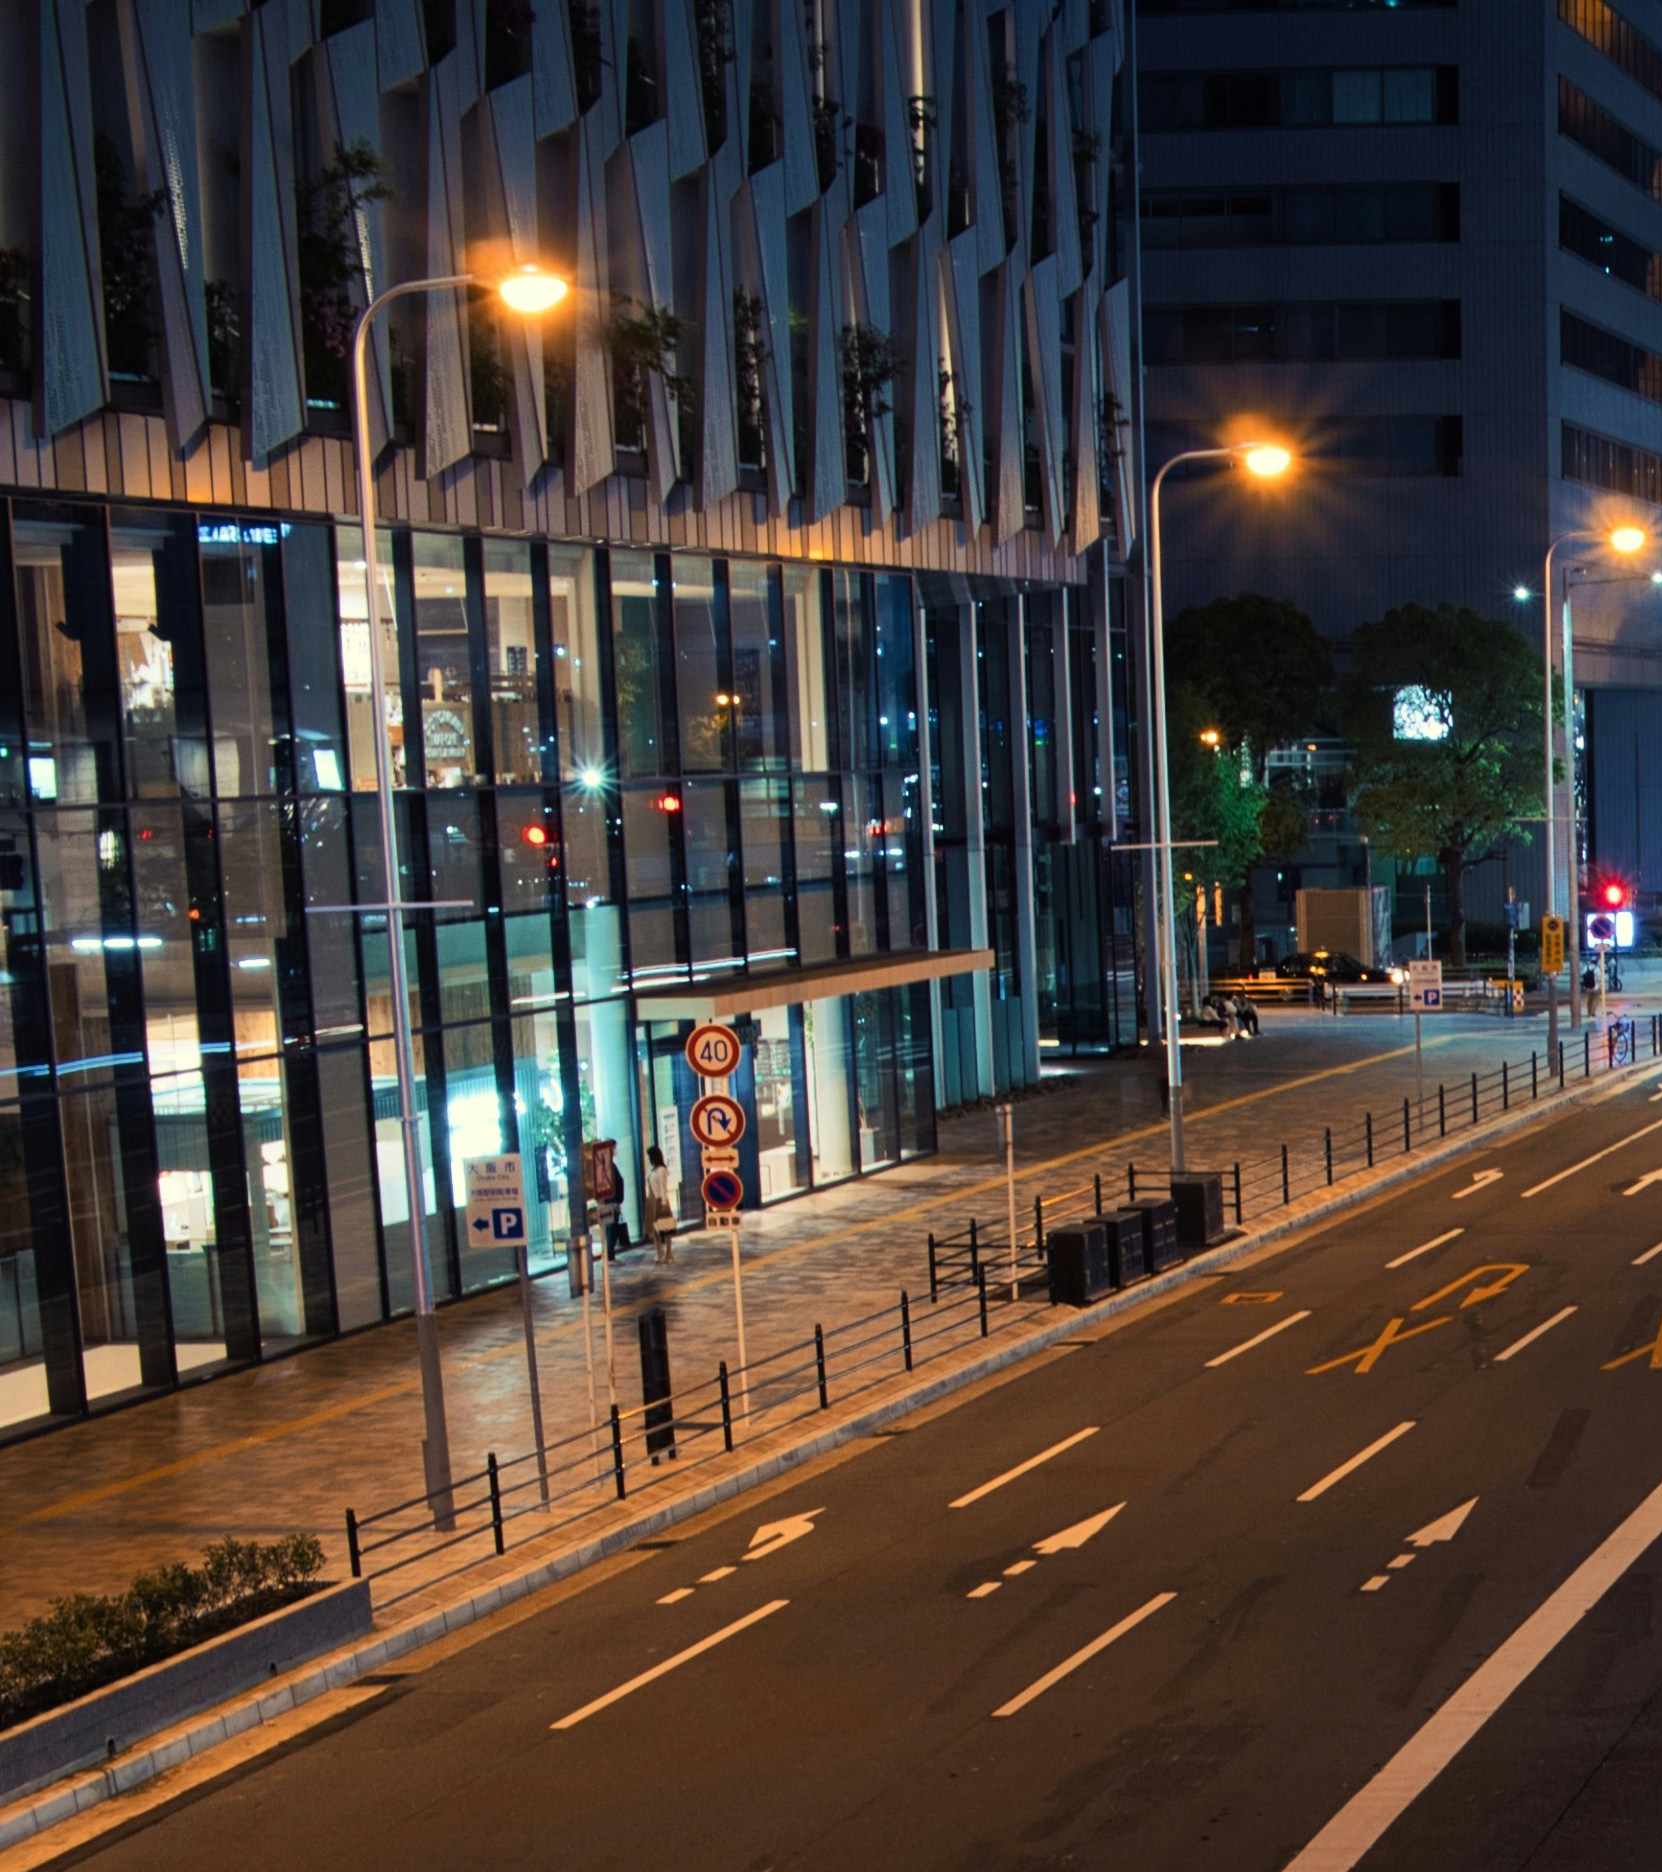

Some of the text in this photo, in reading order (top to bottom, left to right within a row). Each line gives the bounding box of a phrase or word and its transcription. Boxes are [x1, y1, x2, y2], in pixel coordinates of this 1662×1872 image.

[701, 1040, 728, 1063] 40
[500, 1213, 517, 1235] P
[708, 1215, 741, 1227] 自動車
